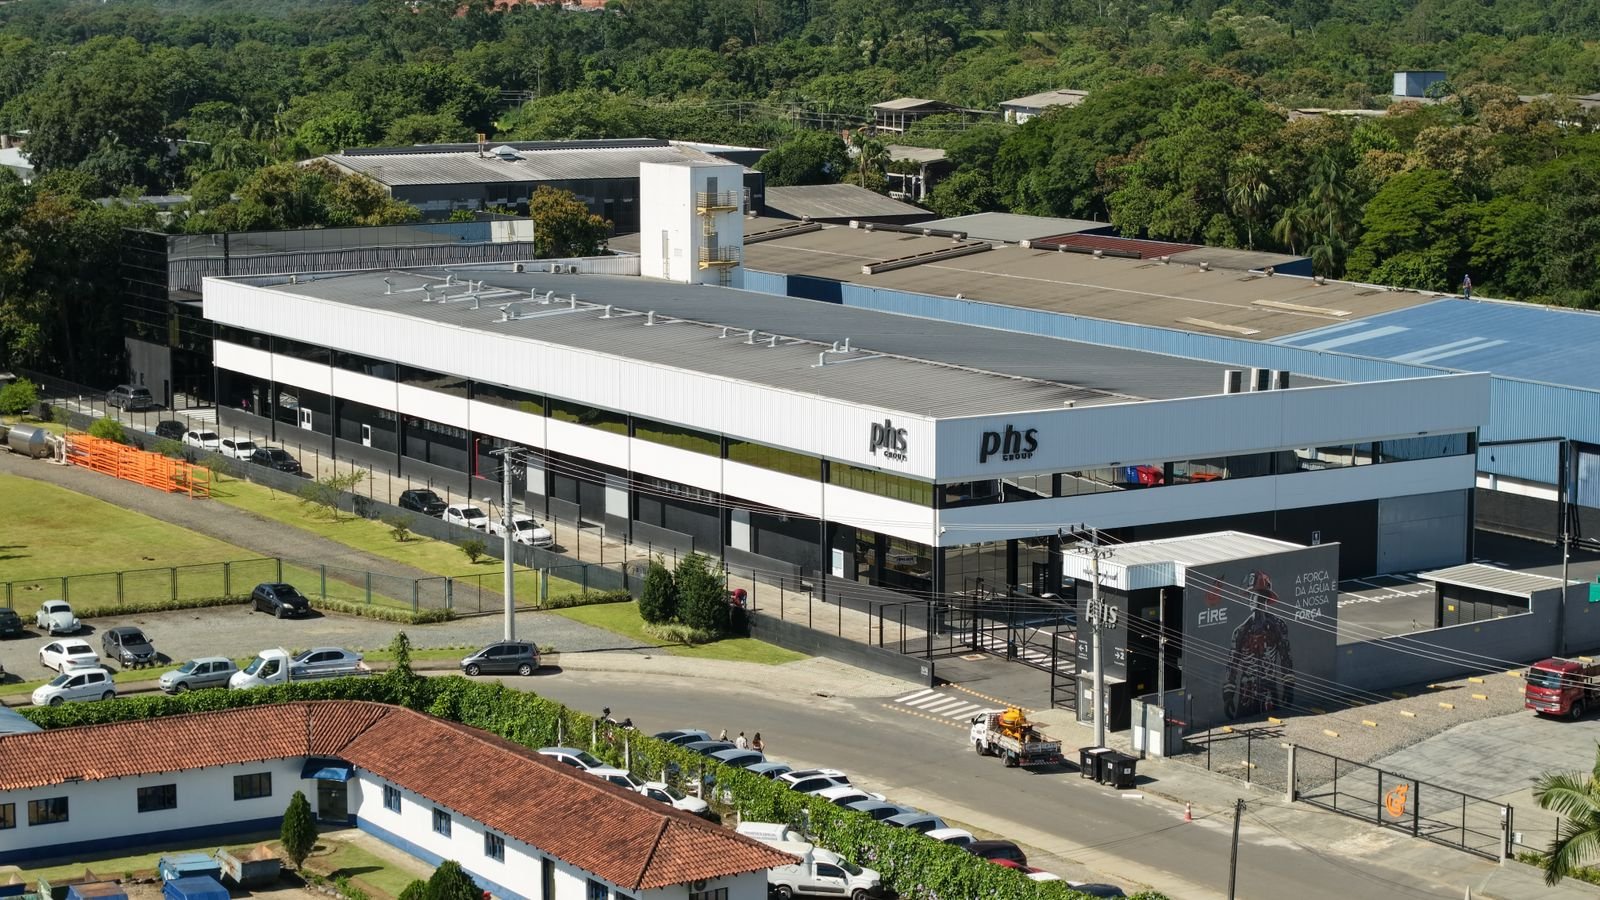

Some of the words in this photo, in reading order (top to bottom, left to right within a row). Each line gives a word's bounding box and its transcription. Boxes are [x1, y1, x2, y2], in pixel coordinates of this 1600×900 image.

[869, 418, 908, 453] phs
[979, 424, 1038, 464] phs
[884, 450, 907, 461] GROUP
[1002, 452, 1033, 461] GROUP
[1295, 575, 1301, 584] A
[1303, 570, 1329, 583] FORÇA
[1295, 586, 1306, 597] DA
[1308, 582, 1330, 595] ÁGUA
[1295, 599, 1301, 608] A
[1302, 595, 1329, 608] NOSSA
[1120, 652, 1125, 661] 2
